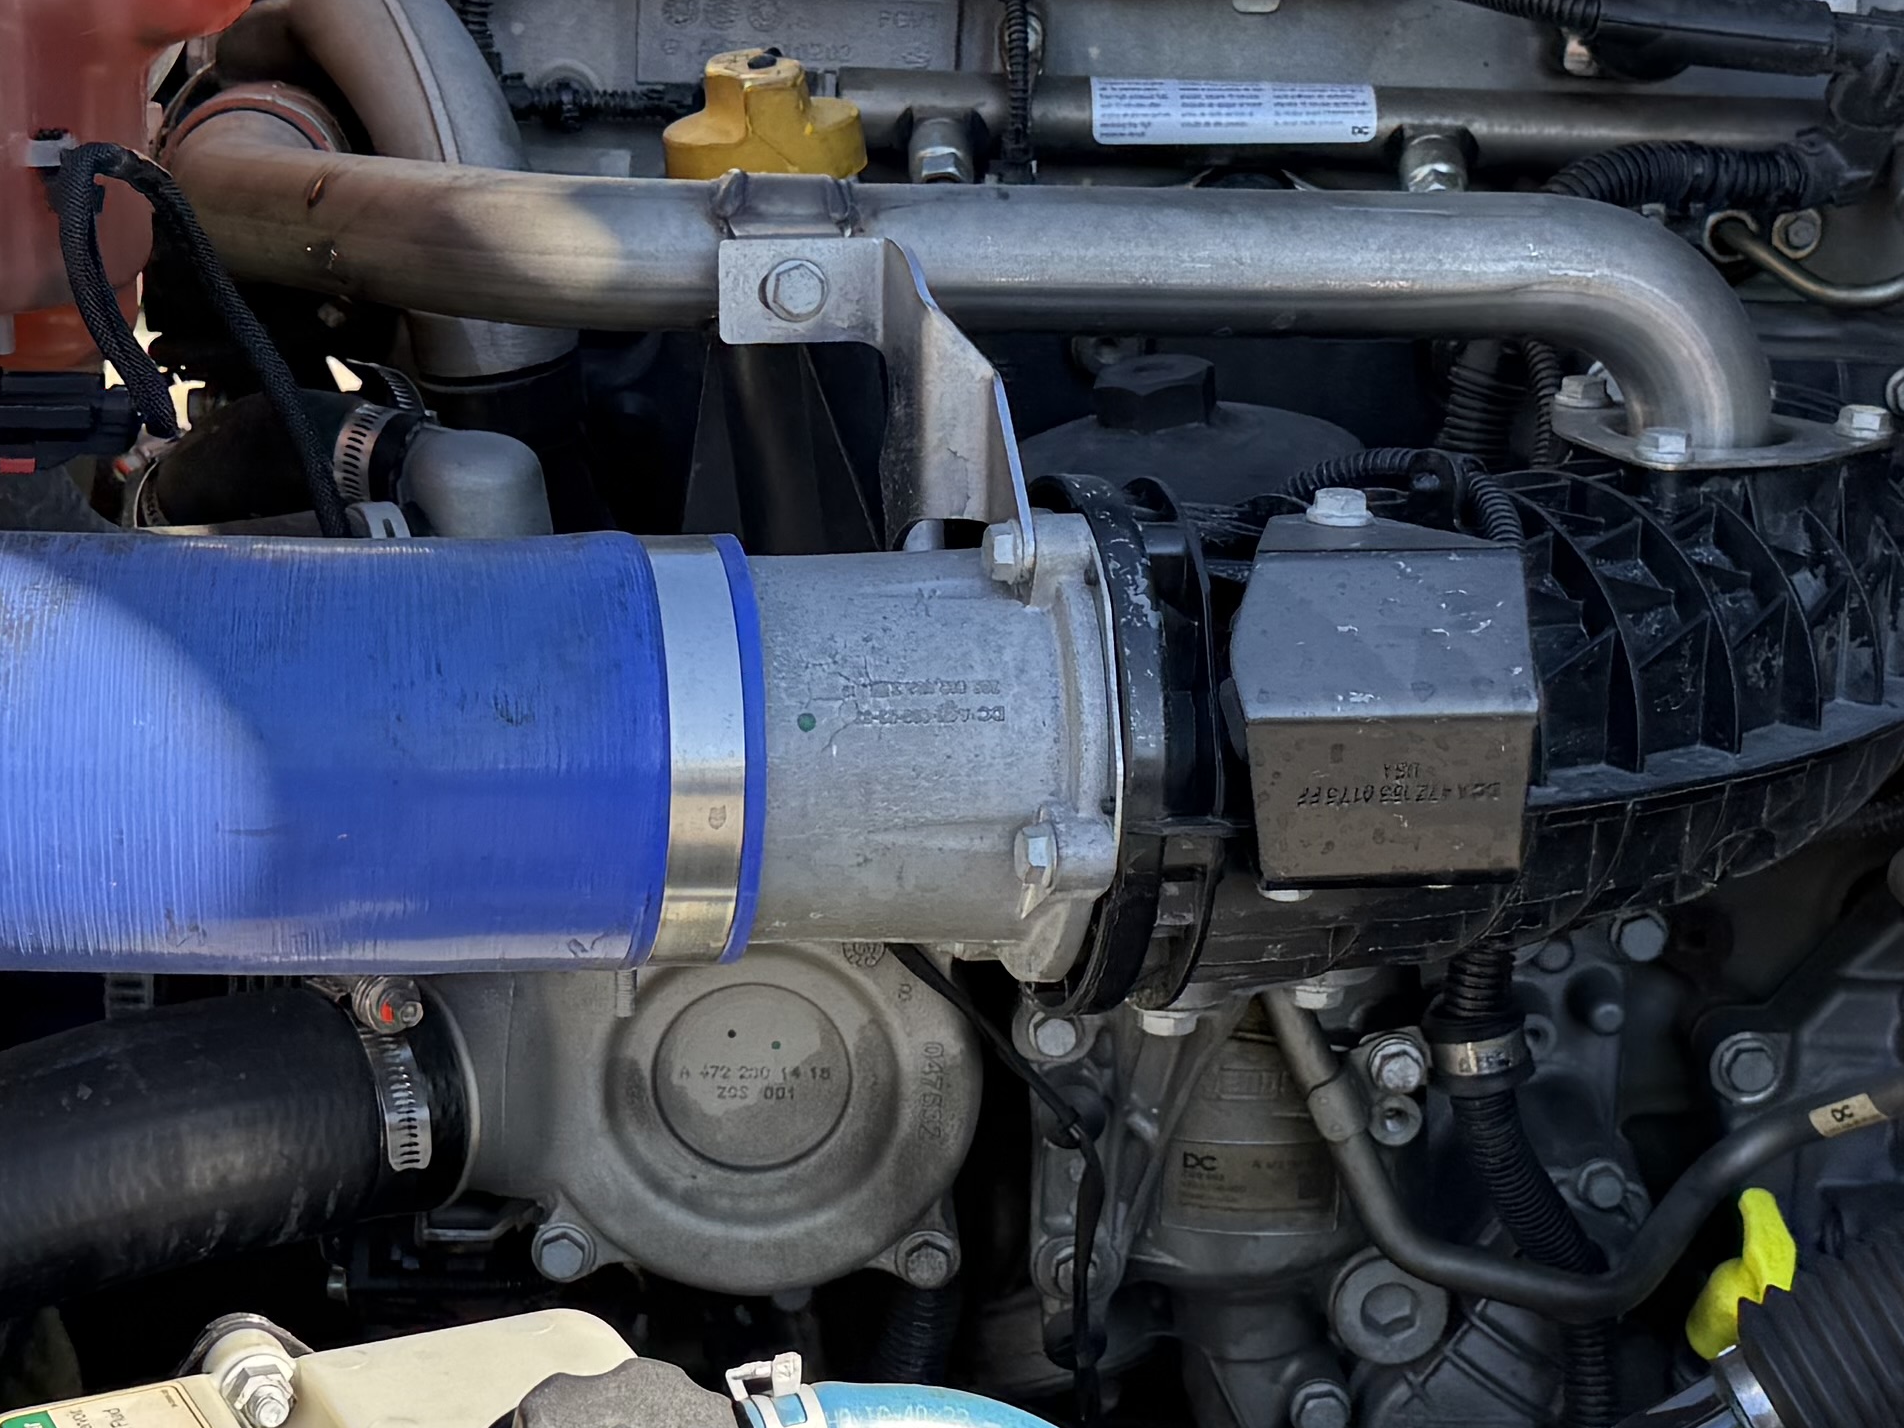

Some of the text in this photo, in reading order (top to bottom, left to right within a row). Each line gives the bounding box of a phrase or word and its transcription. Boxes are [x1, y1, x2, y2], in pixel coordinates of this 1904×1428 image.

[762, 1084, 796, 1101] 001
[1830, 1104, 1855, 1124] DC
[1183, 1151, 1218, 1173] DC
